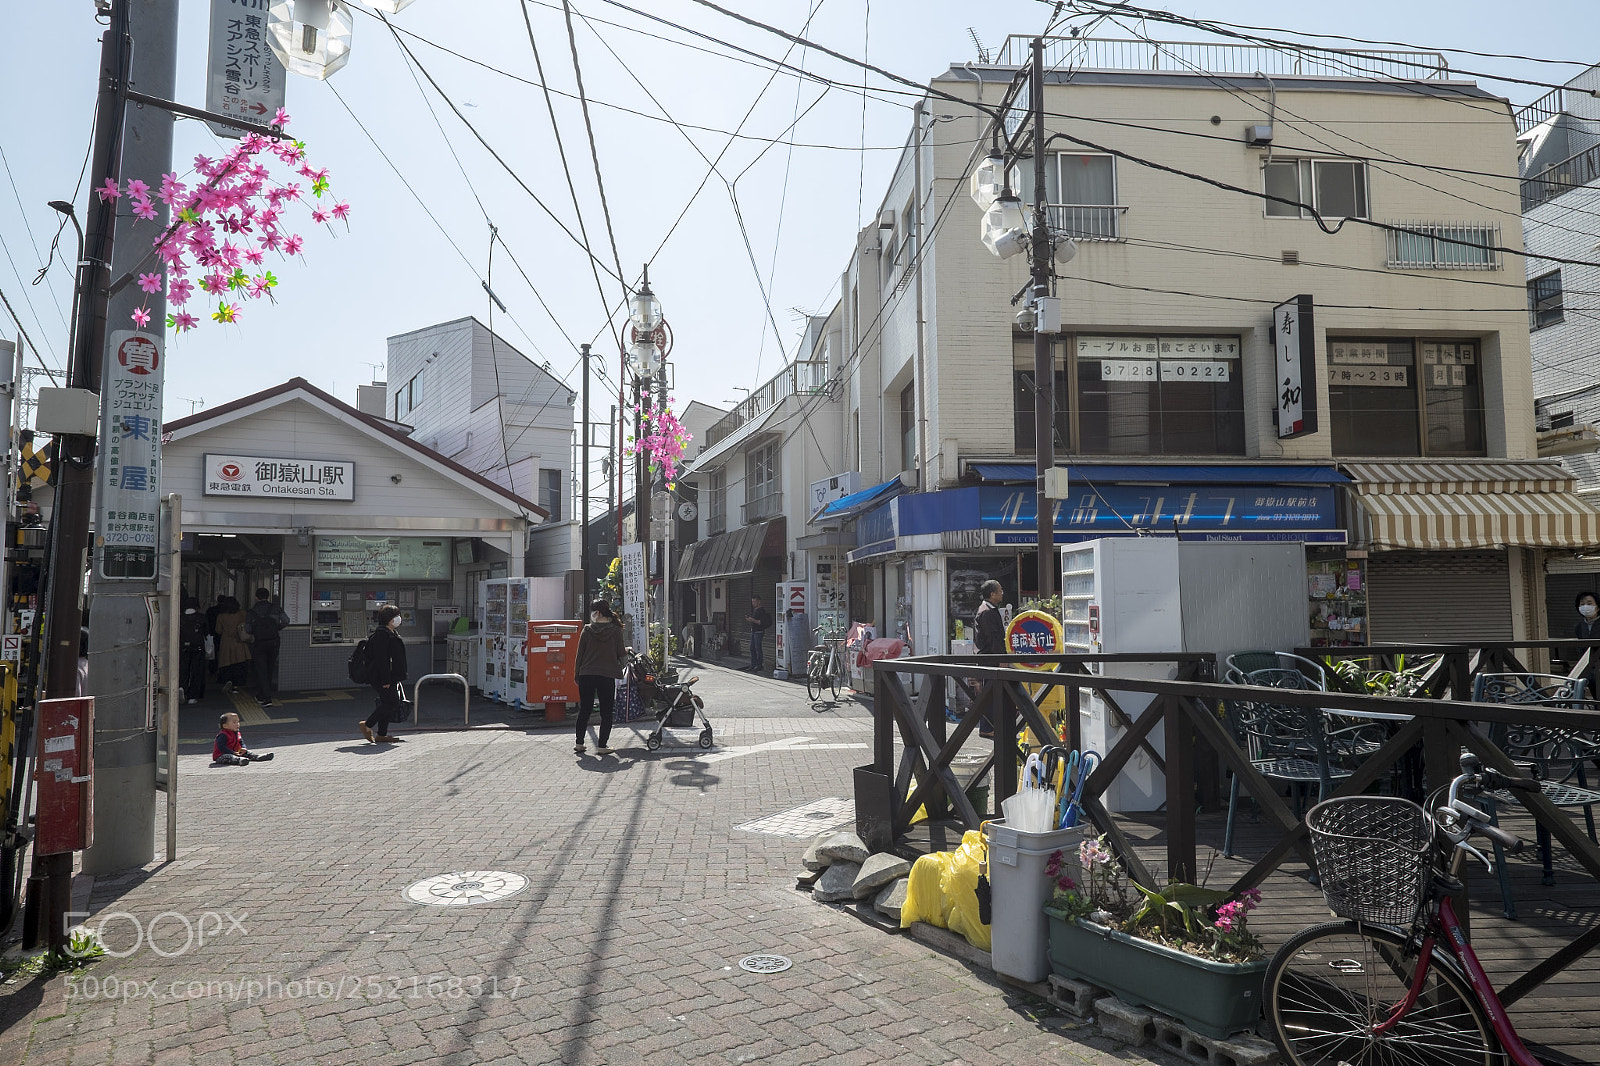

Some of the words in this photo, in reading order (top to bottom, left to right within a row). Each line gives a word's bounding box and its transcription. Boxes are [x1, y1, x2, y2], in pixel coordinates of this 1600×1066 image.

[225, 19, 244, 95] オアシス雪谷
[243, 14, 262, 91] 東急スポーツ
[1079, 341, 1237, 354] テーブルお座敷ございます
[1334, 348, 1386, 359] 営業時間
[122, 341, 156, 372] 質
[1424, 350, 1472, 360] 定休日
[114, 379, 159, 394] ブランド品
[255, 461, 344, 485] 御嶽山駅
[209, 482, 252, 492] 東急電鉄
[262, 483, 316, 495] Ontakesan
[319, 485, 337, 496] Sta.
[1254, 497, 1318, 507] 御嶽山駅前店
[108, 511, 155, 522] 雪谷商店街
[107, 523, 154, 533] 雪谷大塚駅そば
[106, 533, 155, 543] 3720-0783
[941, 529, 990, 550] MIMATSU
[1011, 632, 1055, 648] 車両通行止
